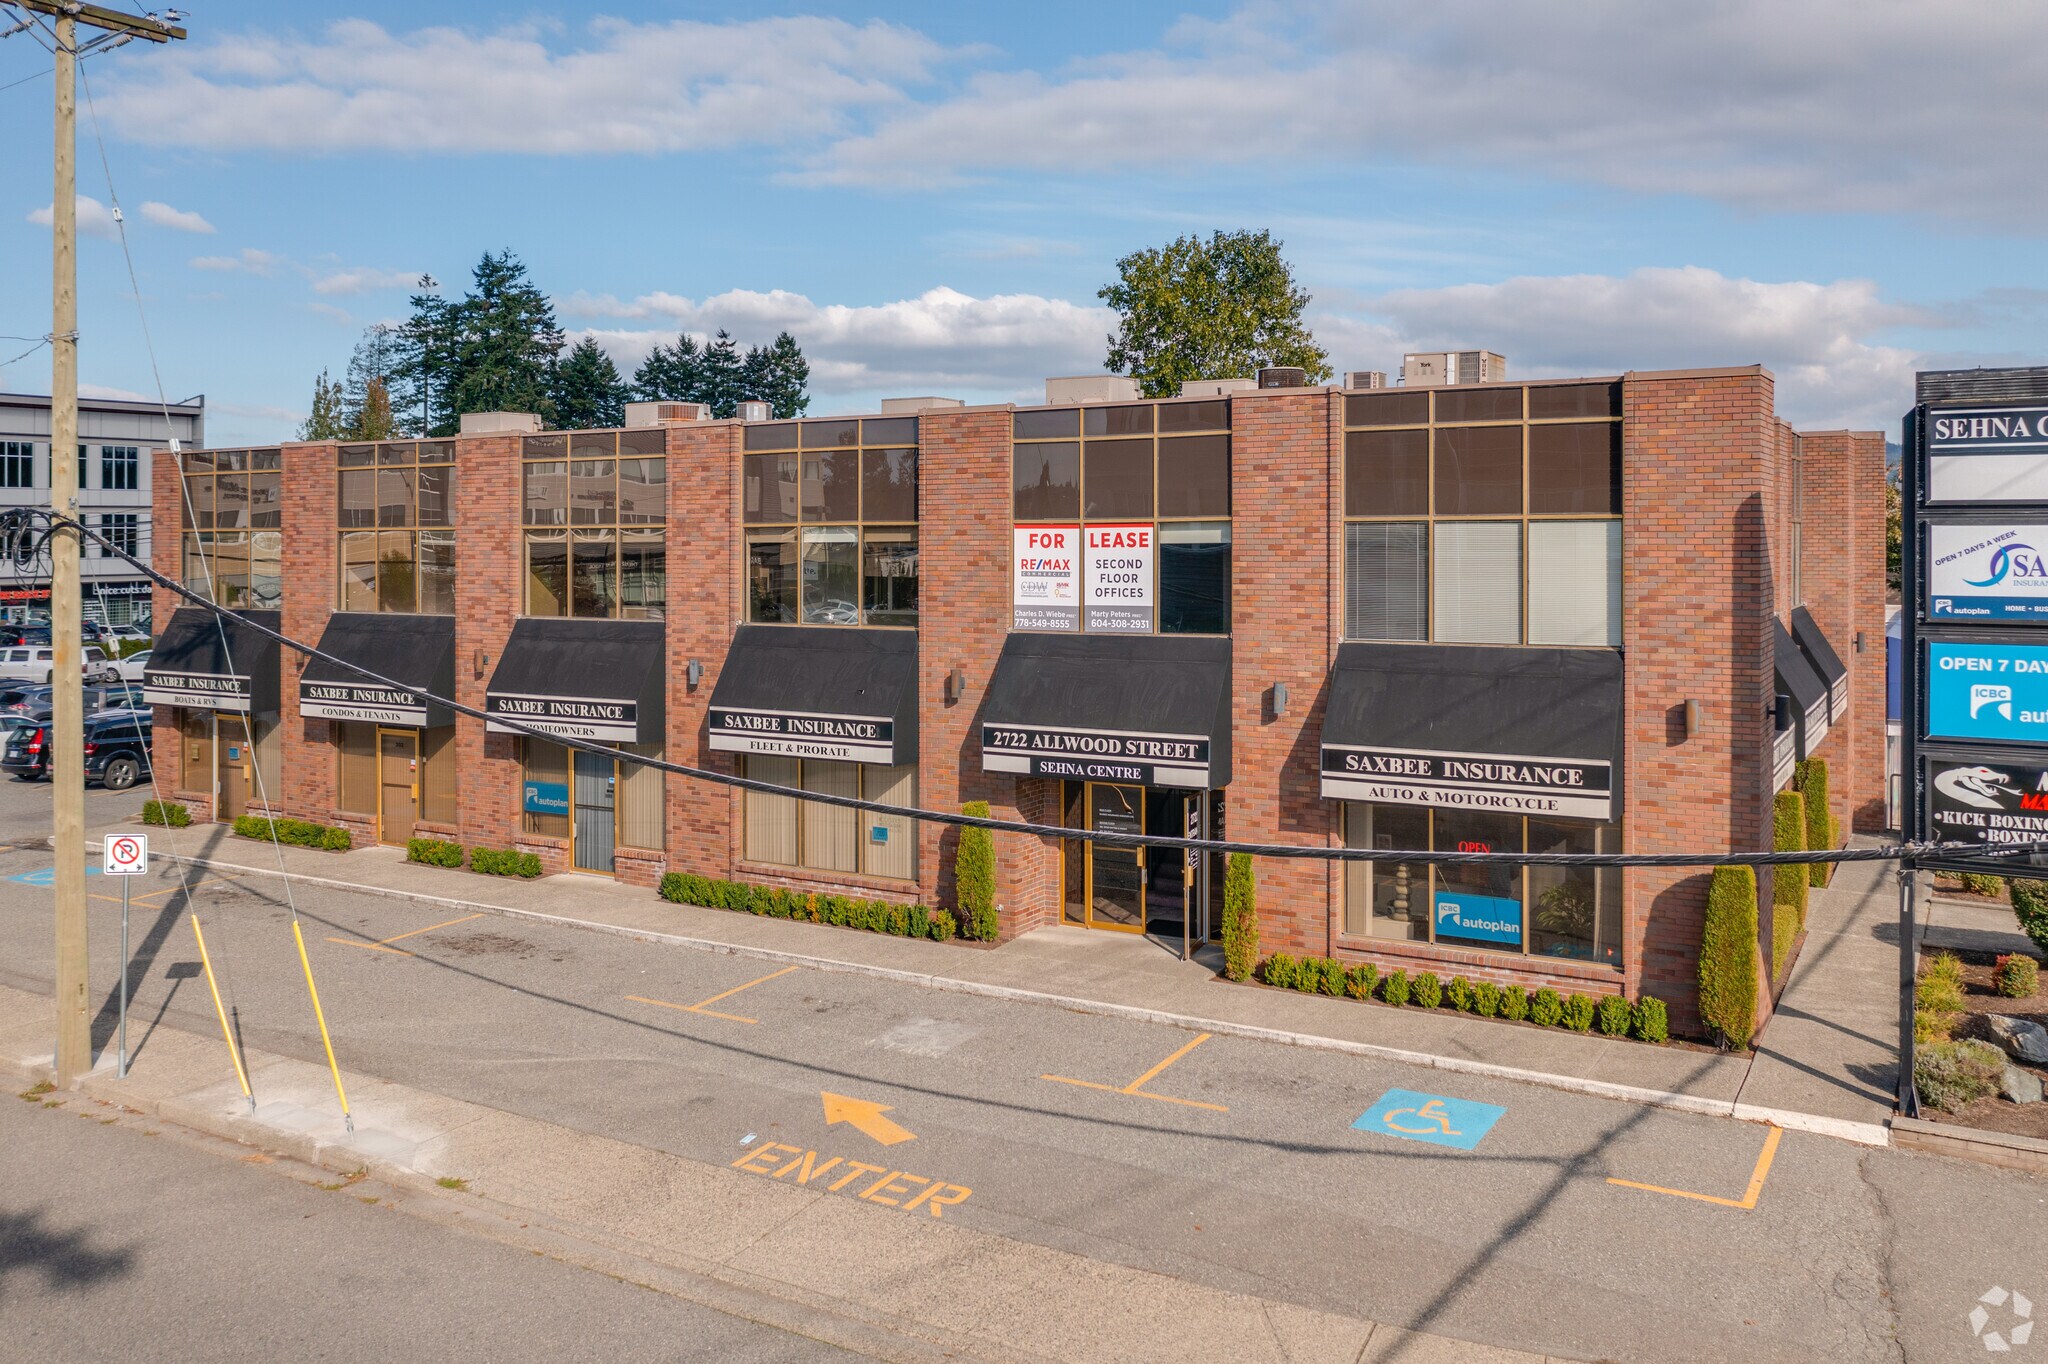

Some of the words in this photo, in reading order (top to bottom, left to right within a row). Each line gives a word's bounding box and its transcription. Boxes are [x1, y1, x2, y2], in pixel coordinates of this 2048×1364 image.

[1935, 416, 2032, 440] SEHNA
[1029, 533, 1065, 548] FOR
[1089, 532, 1149, 548] LEASE
[1934, 554, 1957, 566] OPEN
[1963, 542, 1985, 555] DAYS
[1993, 530, 2018, 544] WEEK
[1021, 559, 1070, 570] RE/MAX
[1095, 559, 1143, 569] SECOND
[1100, 573, 1139, 583] FLOOR
[1095, 587, 1144, 598] OFFICES
[1046, 610, 1066, 618] Wiebe
[1091, 610, 1109, 618] Marty
[1953, 607, 1990, 615] autoplan
[1014, 618, 1070, 628] 778-549-8555
[1091, 618, 1149, 629] 604-308-2931
[1939, 657, 1992, 671] OPEN
[1997, 659, 2009, 672] 7
[152, 675, 185, 688] SAXBEE
[188, 678, 241, 692] INSURANCE
[174, 696, 196, 705] BOATS
[309, 686, 349, 700] SAXBEE
[353, 689, 415, 704] INSURANCE
[1975, 688, 2007, 698] ICBC
[322, 707, 355, 717] CONDOS
[363, 710, 401, 721] TENANTS
[499, 699, 545, 714] SAXBEE
[550, 702, 624, 719] INSURANCE
[724, 714, 781, 731] SAXBEE
[787, 718, 877, 738] INSURANCE
[750, 741, 783, 752] FLEET
[785, 744, 794, 752] &
[796, 744, 850, 757] PRORATE
[993, 731, 1028, 748] 2722
[1031, 734, 1122, 754] ALLWOOD
[1125, 740, 1199, 759] STREET
[1039, 761, 1085, 776] SEHNA
[1087, 764, 1142, 780] CENTRE
[1345, 754, 1432, 776] SAXBEE
[1442, 760, 1584, 786] INSURANCE
[538, 798, 568, 808] autoplan
[1369, 786, 1414, 799] AUTO
[1418, 790, 1430, 801] &
[1434, 792, 1559, 811] MOTORCYCLE
[1458, 840, 1491, 853] OPEN
[1440, 904, 1458, 912] ICBC
[1462, 917, 1520, 934] autoplan
[731, 1140, 973, 1218] ENTER
